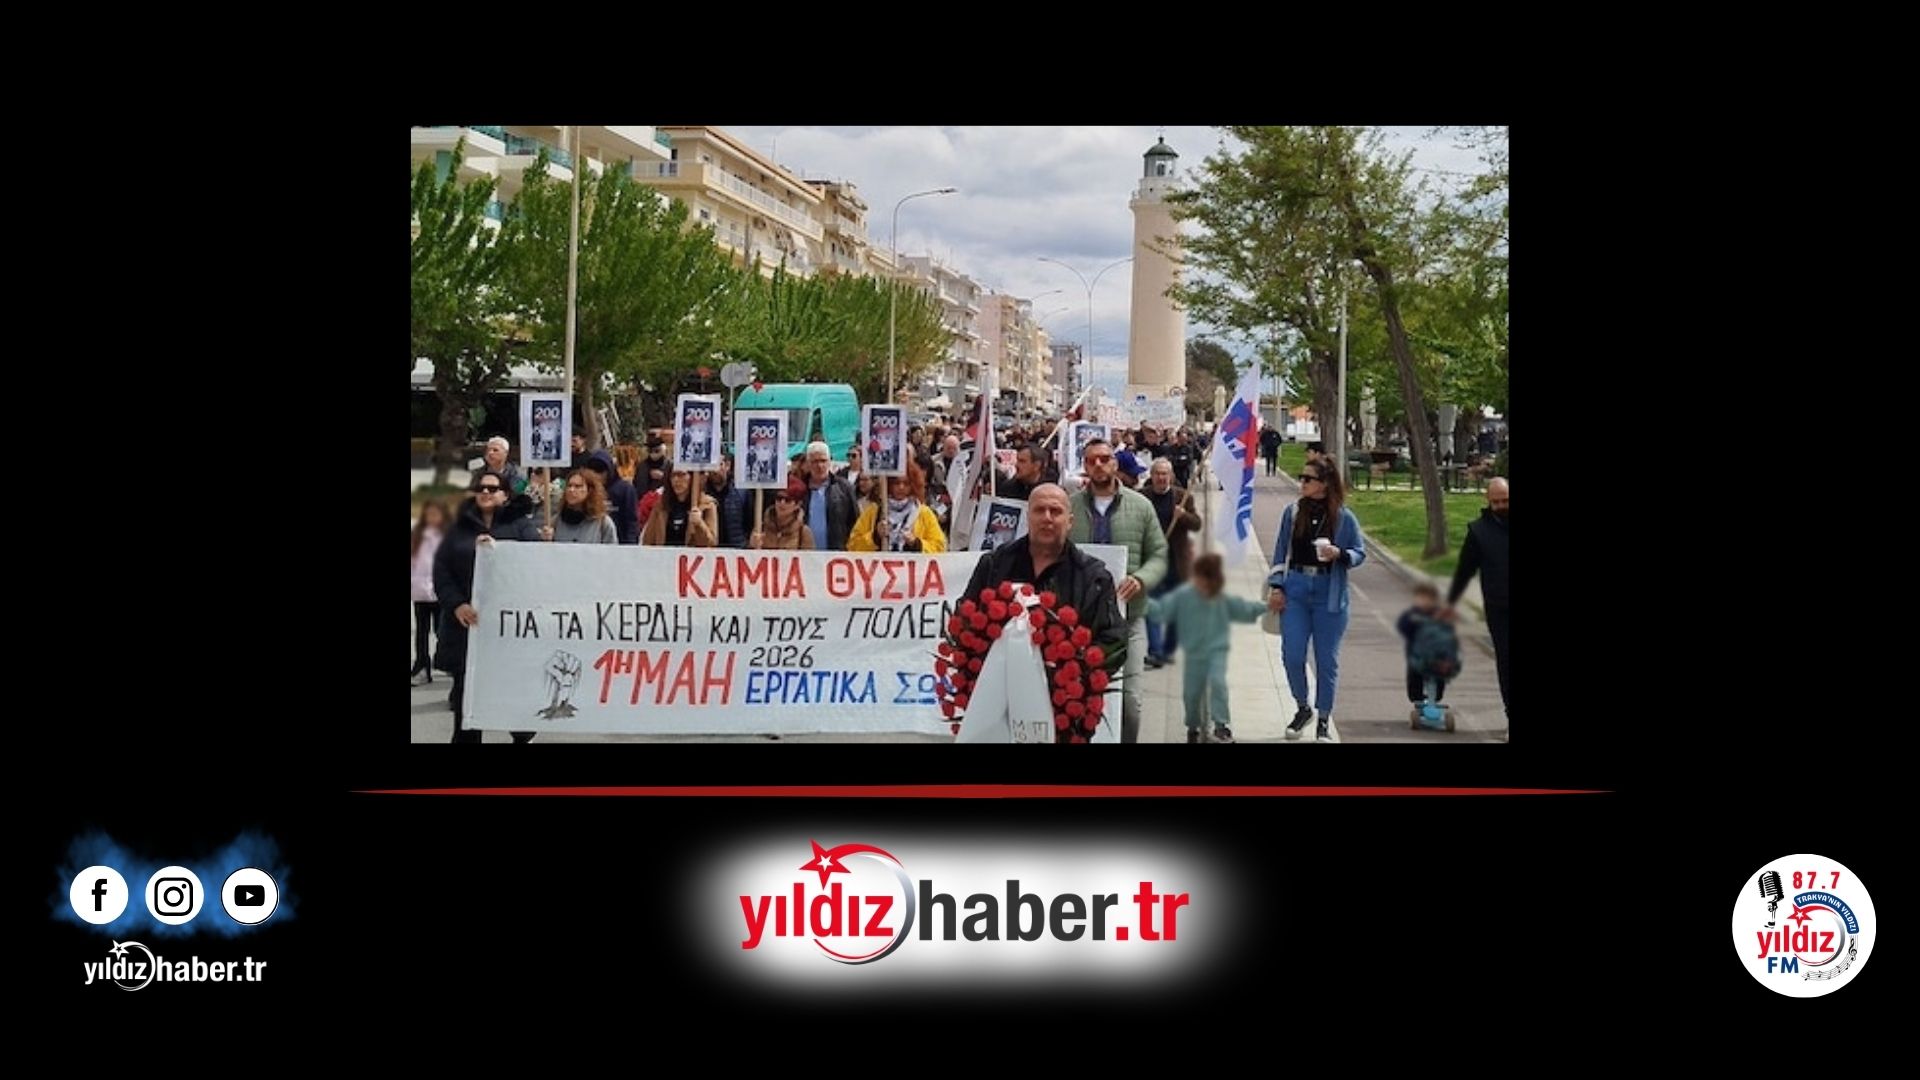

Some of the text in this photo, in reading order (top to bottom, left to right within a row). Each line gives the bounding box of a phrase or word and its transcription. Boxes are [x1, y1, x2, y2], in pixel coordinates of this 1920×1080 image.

[535, 407, 560, 420] 200
[685, 408, 711, 421] 200
[873, 415, 898, 429] 200
[751, 425, 777, 439] 200
[991, 511, 1018, 528] 200
[678, 554, 945, 600] ΚΑΜΙΑ ΘΥΣΙΑ
[499, 610, 539, 639] ΓΙΑ
[551, 611, 584, 641] ΤΑ
[596, 602, 693, 643] ΚΕΡΔΗ
[709, 615, 750, 644] ΚΑΙ
[763, 616, 829, 643] ΤΟΥΣ
[749, 645, 815, 668] 2026
[744, 670, 878, 705] ΕΡΓΑΤΙΚΑ
